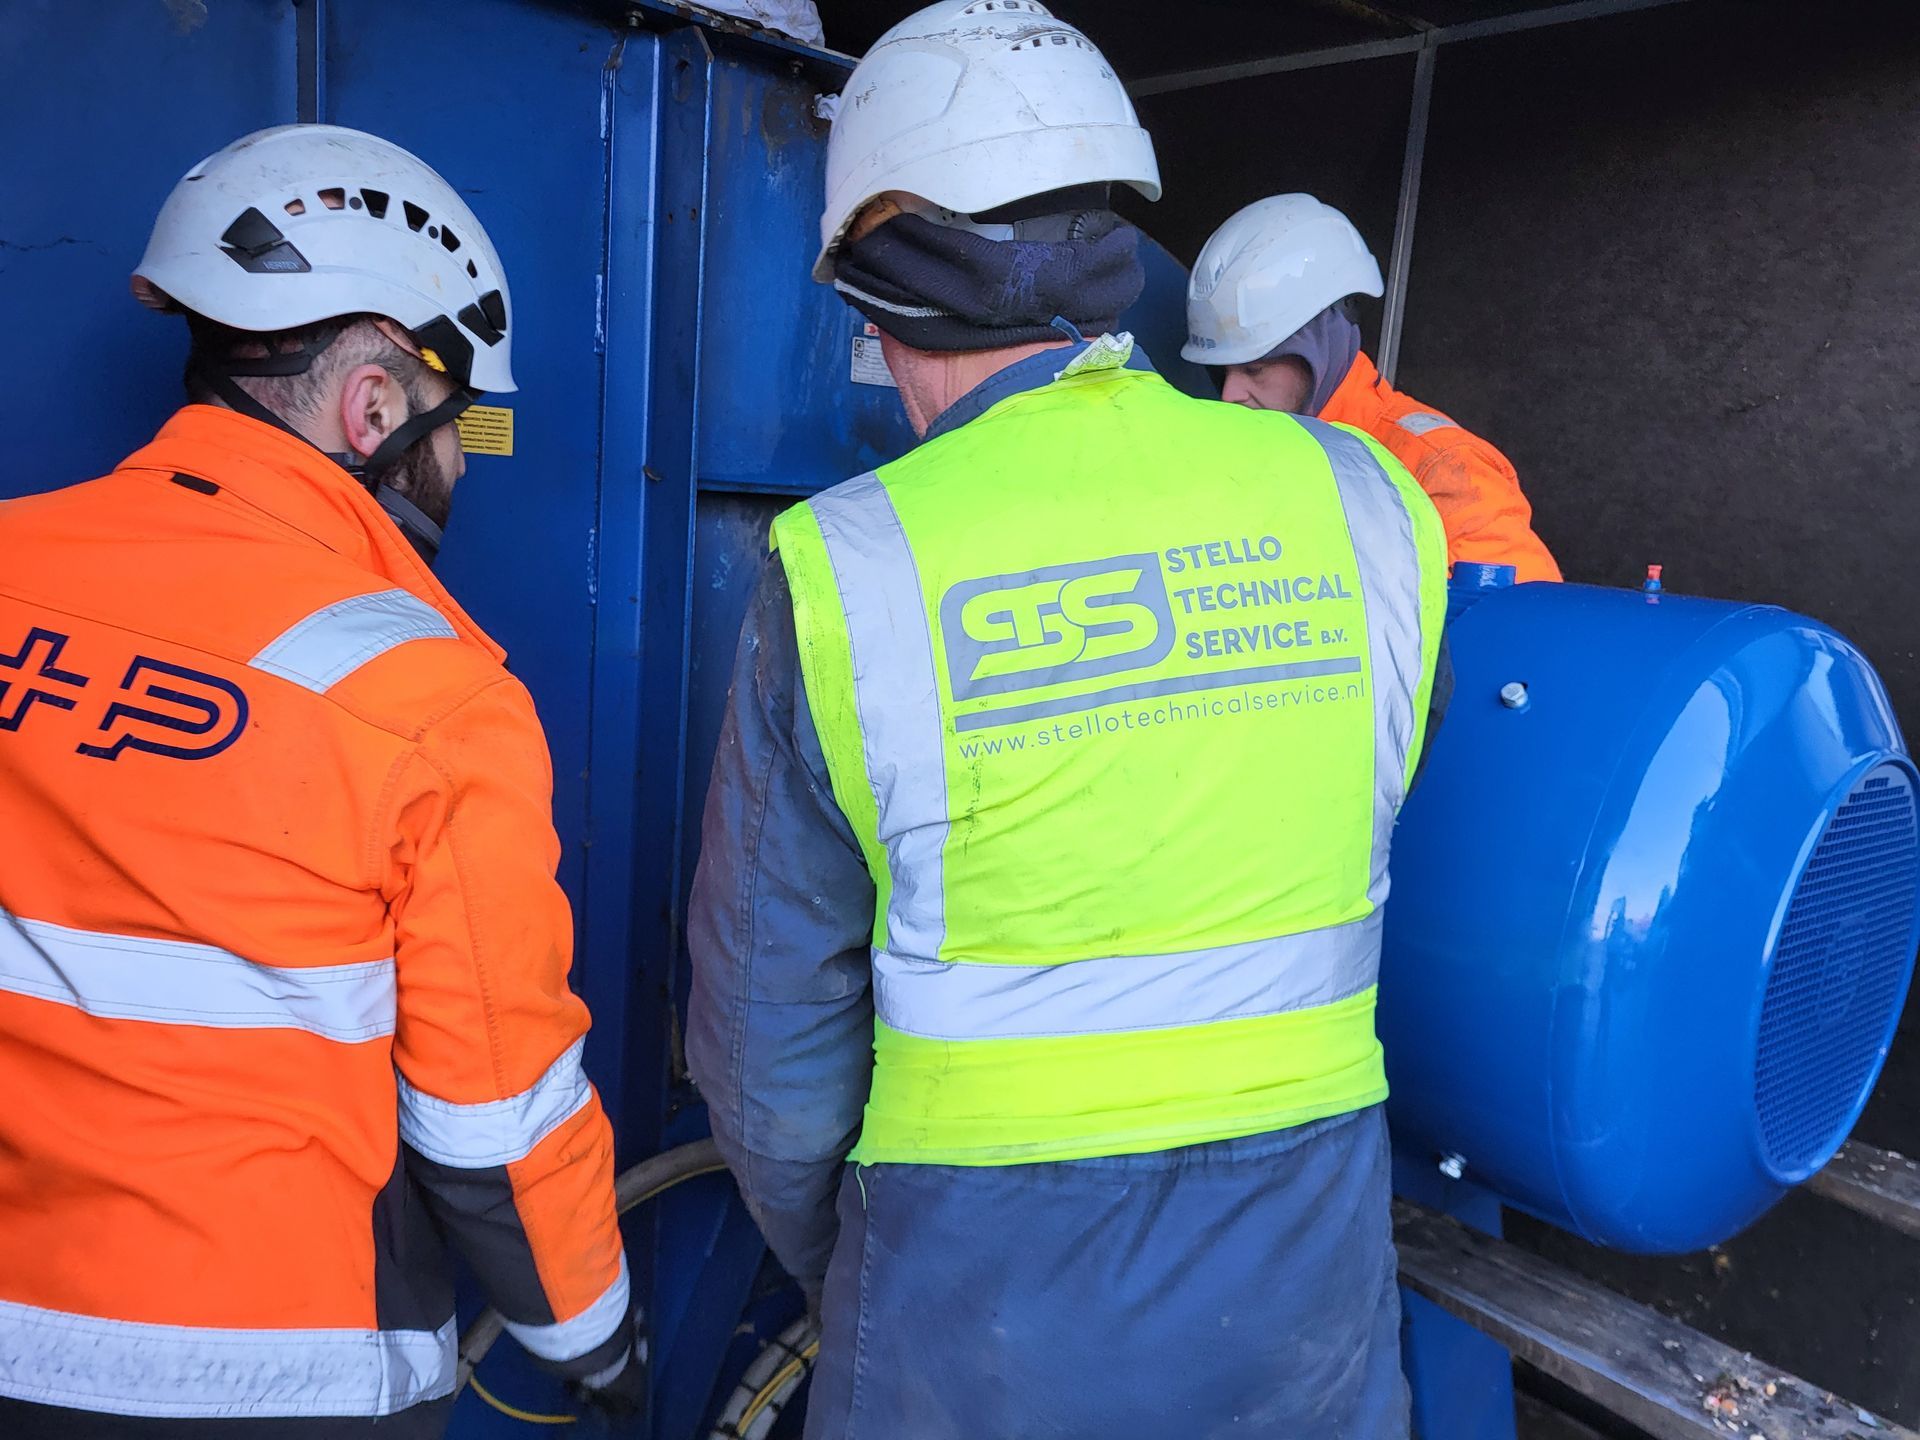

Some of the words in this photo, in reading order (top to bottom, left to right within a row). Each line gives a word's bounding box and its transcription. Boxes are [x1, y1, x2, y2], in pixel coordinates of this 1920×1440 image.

[1165, 536, 1282, 573] STELLO
[1173, 575, 1352, 614] TECHNICAL
[1186, 621, 1313, 659] SERVICE
[1321, 629, 1348, 645] B.V.
[959, 678, 1365, 759] www.stellotechnicalservice.nl
